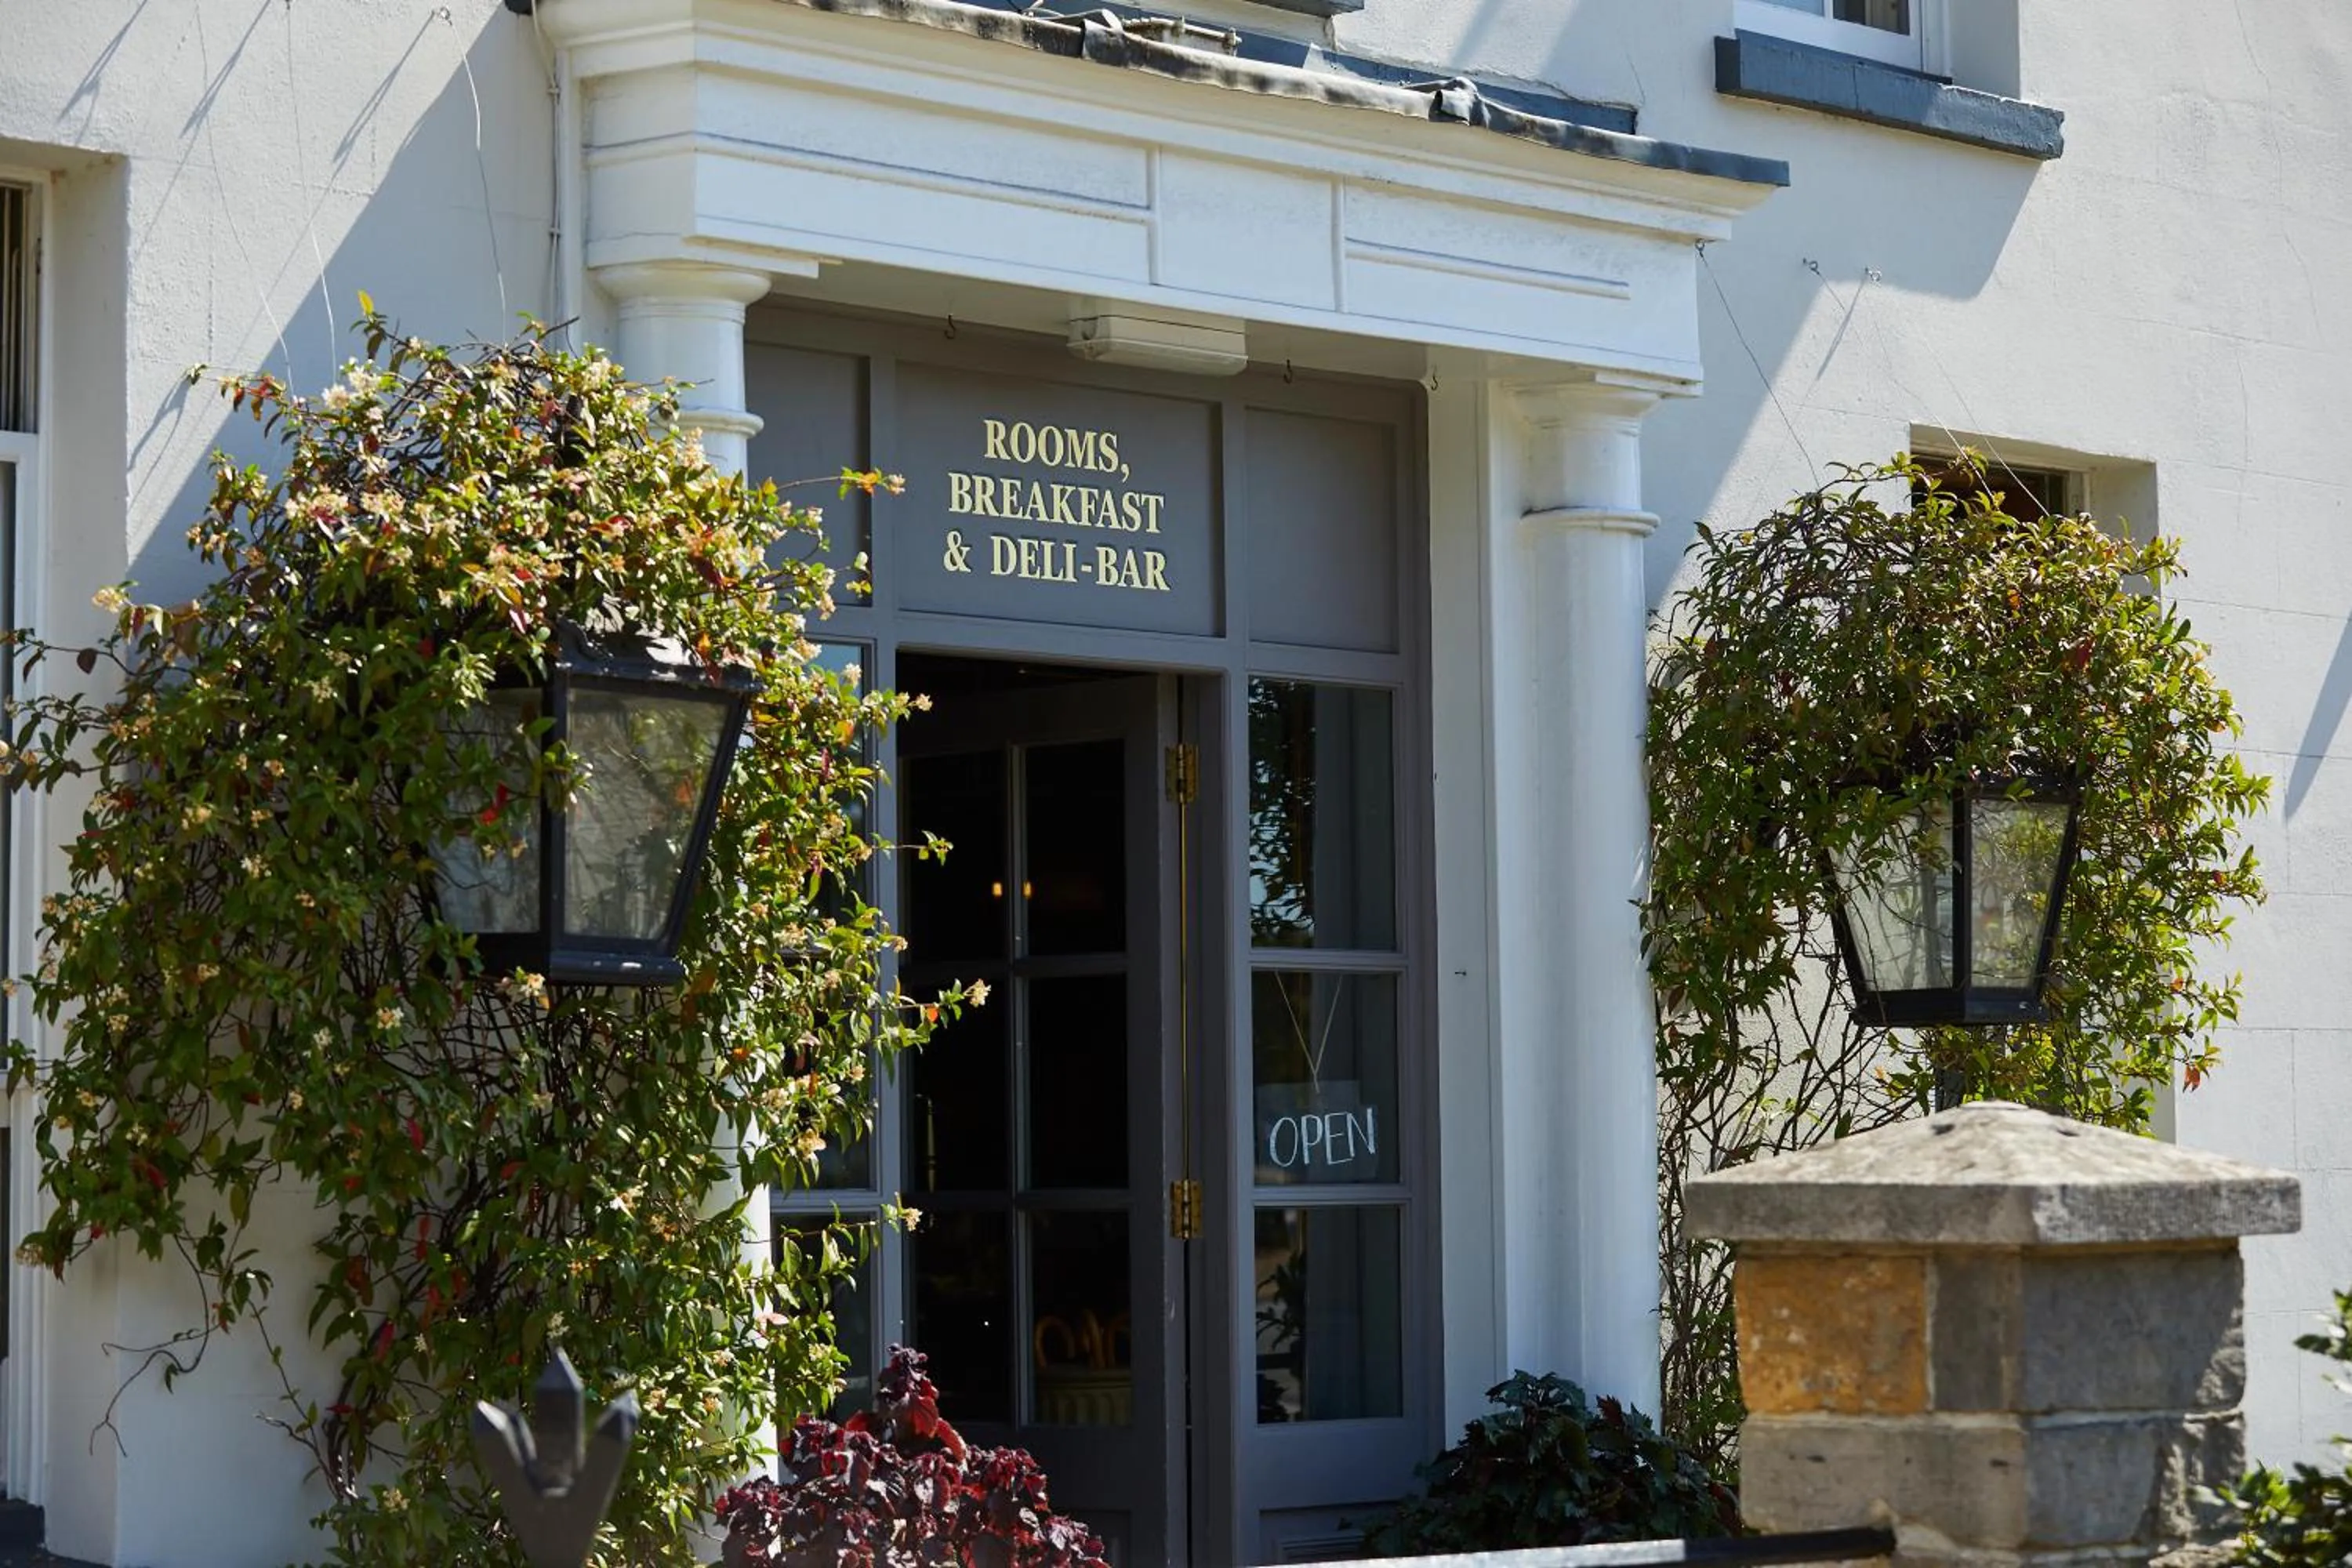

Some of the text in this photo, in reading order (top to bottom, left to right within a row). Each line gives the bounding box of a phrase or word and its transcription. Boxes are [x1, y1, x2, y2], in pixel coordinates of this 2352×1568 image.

[983, 419, 1130, 483] ROOMS,
[948, 472, 1164, 533] BREAKFAST
[943, 531, 1171, 590] & DELI-BAR
[1269, 1108, 1376, 1167] OPEN
